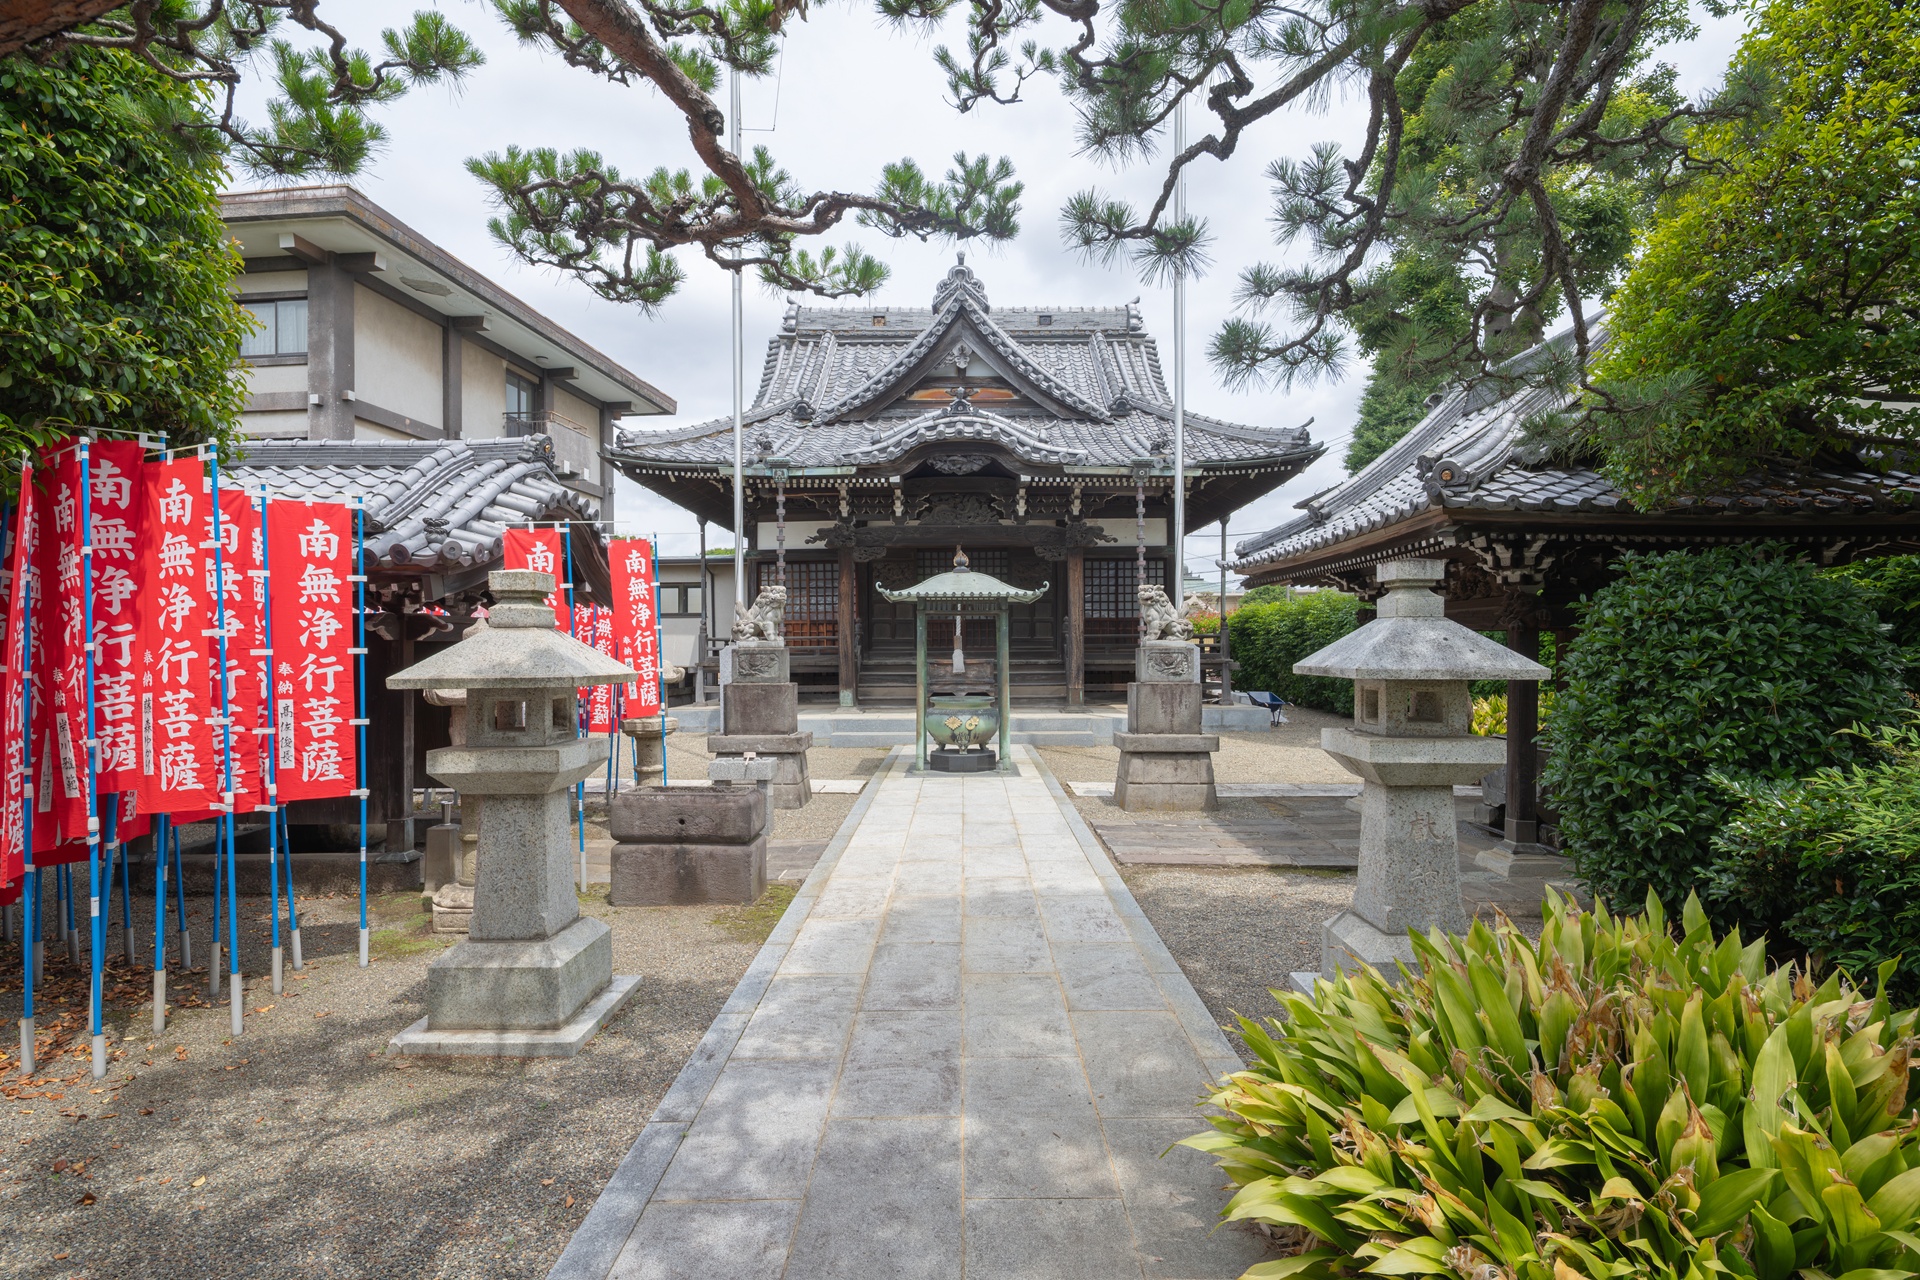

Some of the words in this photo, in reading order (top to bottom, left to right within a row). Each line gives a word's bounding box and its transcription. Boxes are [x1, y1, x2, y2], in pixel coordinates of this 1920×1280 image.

[53, 667, 66, 707] 奉納
[89, 459, 138, 774] 南無浄行菩薩
[143, 649, 154, 687] 奉納
[156, 478, 204, 792] 南無浄行菩薩
[204, 507, 249, 797] 南無浄行菩薩
[278, 662, 294, 694] 奉納
[297, 518, 344, 782] 南無浄行菩薩
[624, 549, 658, 707] 南無浄行菩薩
